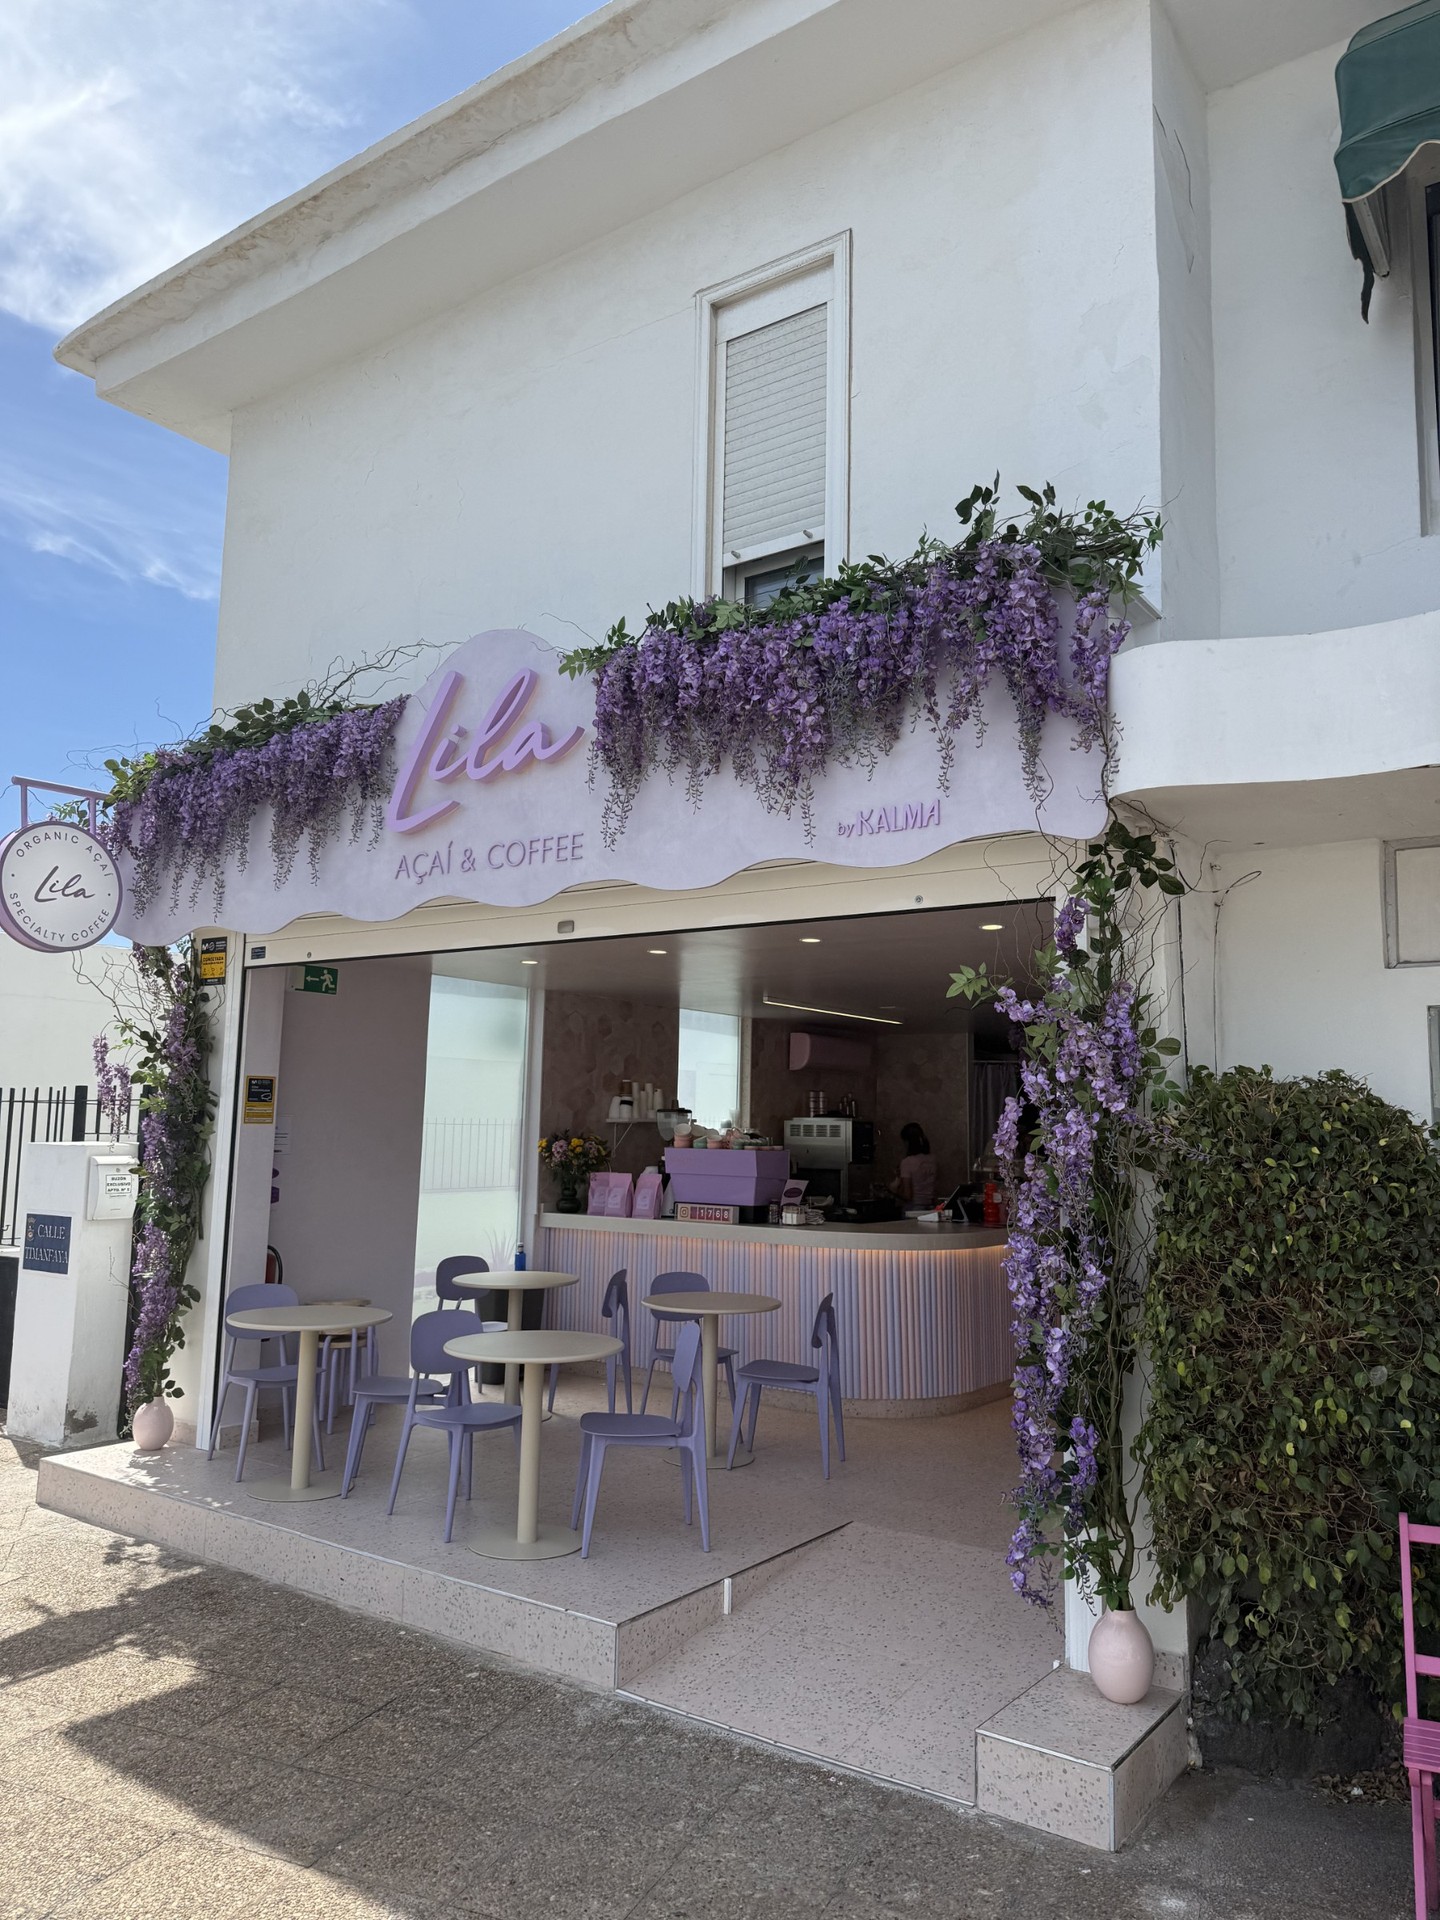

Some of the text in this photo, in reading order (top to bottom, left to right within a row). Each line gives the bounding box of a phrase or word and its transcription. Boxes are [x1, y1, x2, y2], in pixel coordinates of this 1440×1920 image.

[387, 668, 586, 836] Lila
[838, 799, 941, 838] by KALMA
[16, 832, 114, 877] ORGANIC AÇAÍ
[395, 832, 585, 885] AÇAÍ & COFFEE
[34, 865, 95, 903] Lila
[9, 893, 110, 942] SPECIALTY COFFEE
[37, 1224, 66, 1240] CALLE
[701, 1210, 728, 1219] 1768
[25, 1246, 68, 1264] TIMANFAYA
